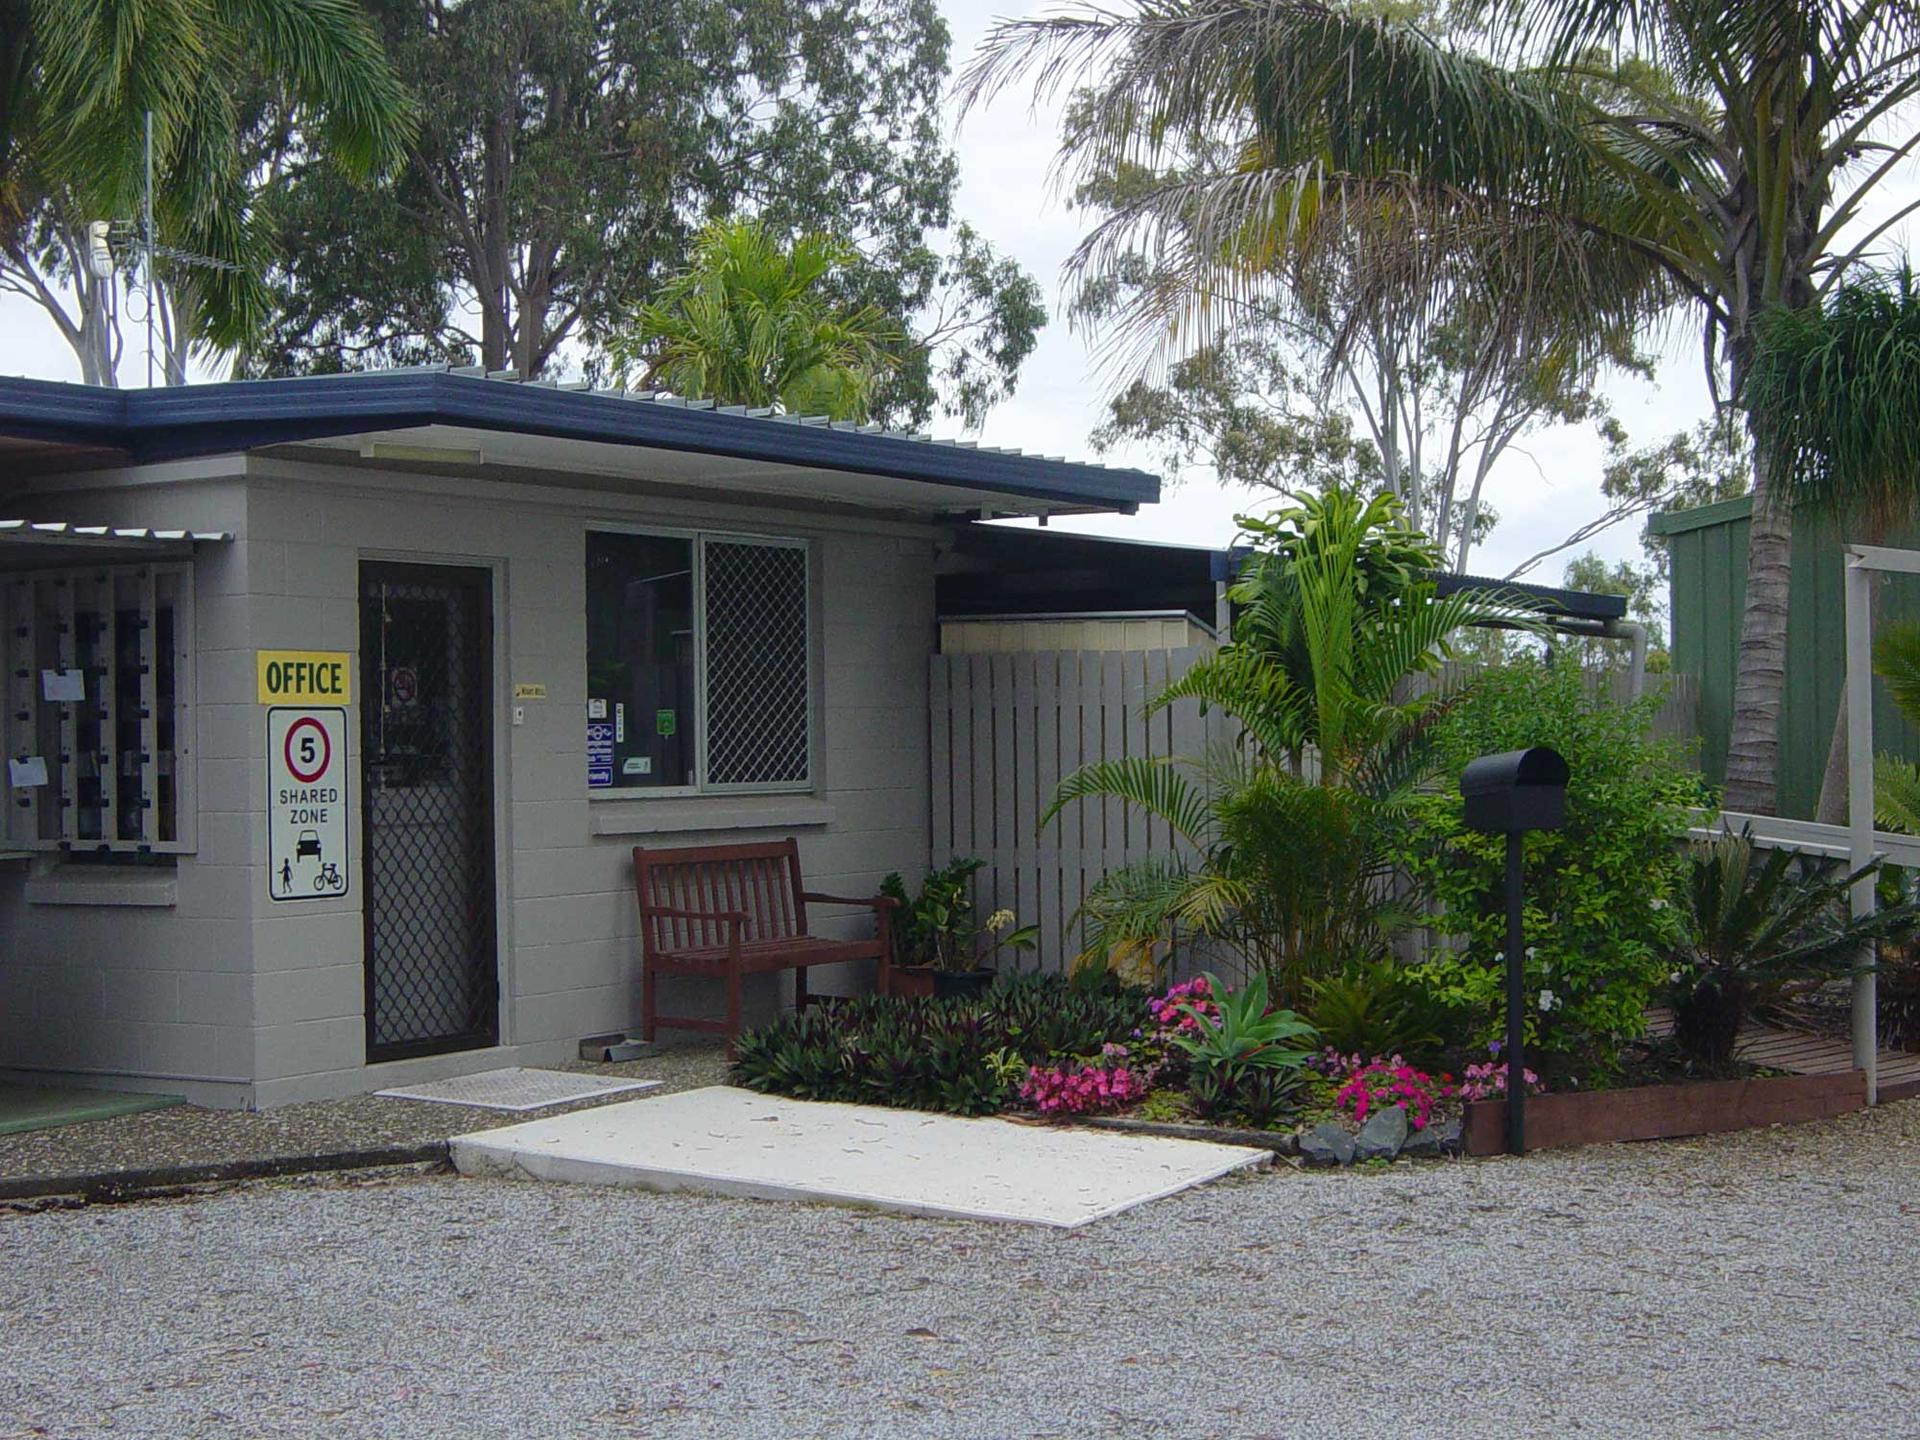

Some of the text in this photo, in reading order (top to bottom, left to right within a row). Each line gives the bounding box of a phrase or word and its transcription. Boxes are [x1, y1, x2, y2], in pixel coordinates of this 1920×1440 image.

[266, 661, 343, 694] OFFICE
[300, 737, 316, 764] 5
[280, 788, 338, 804] SHARED
[290, 808, 328, 824] ZONE
